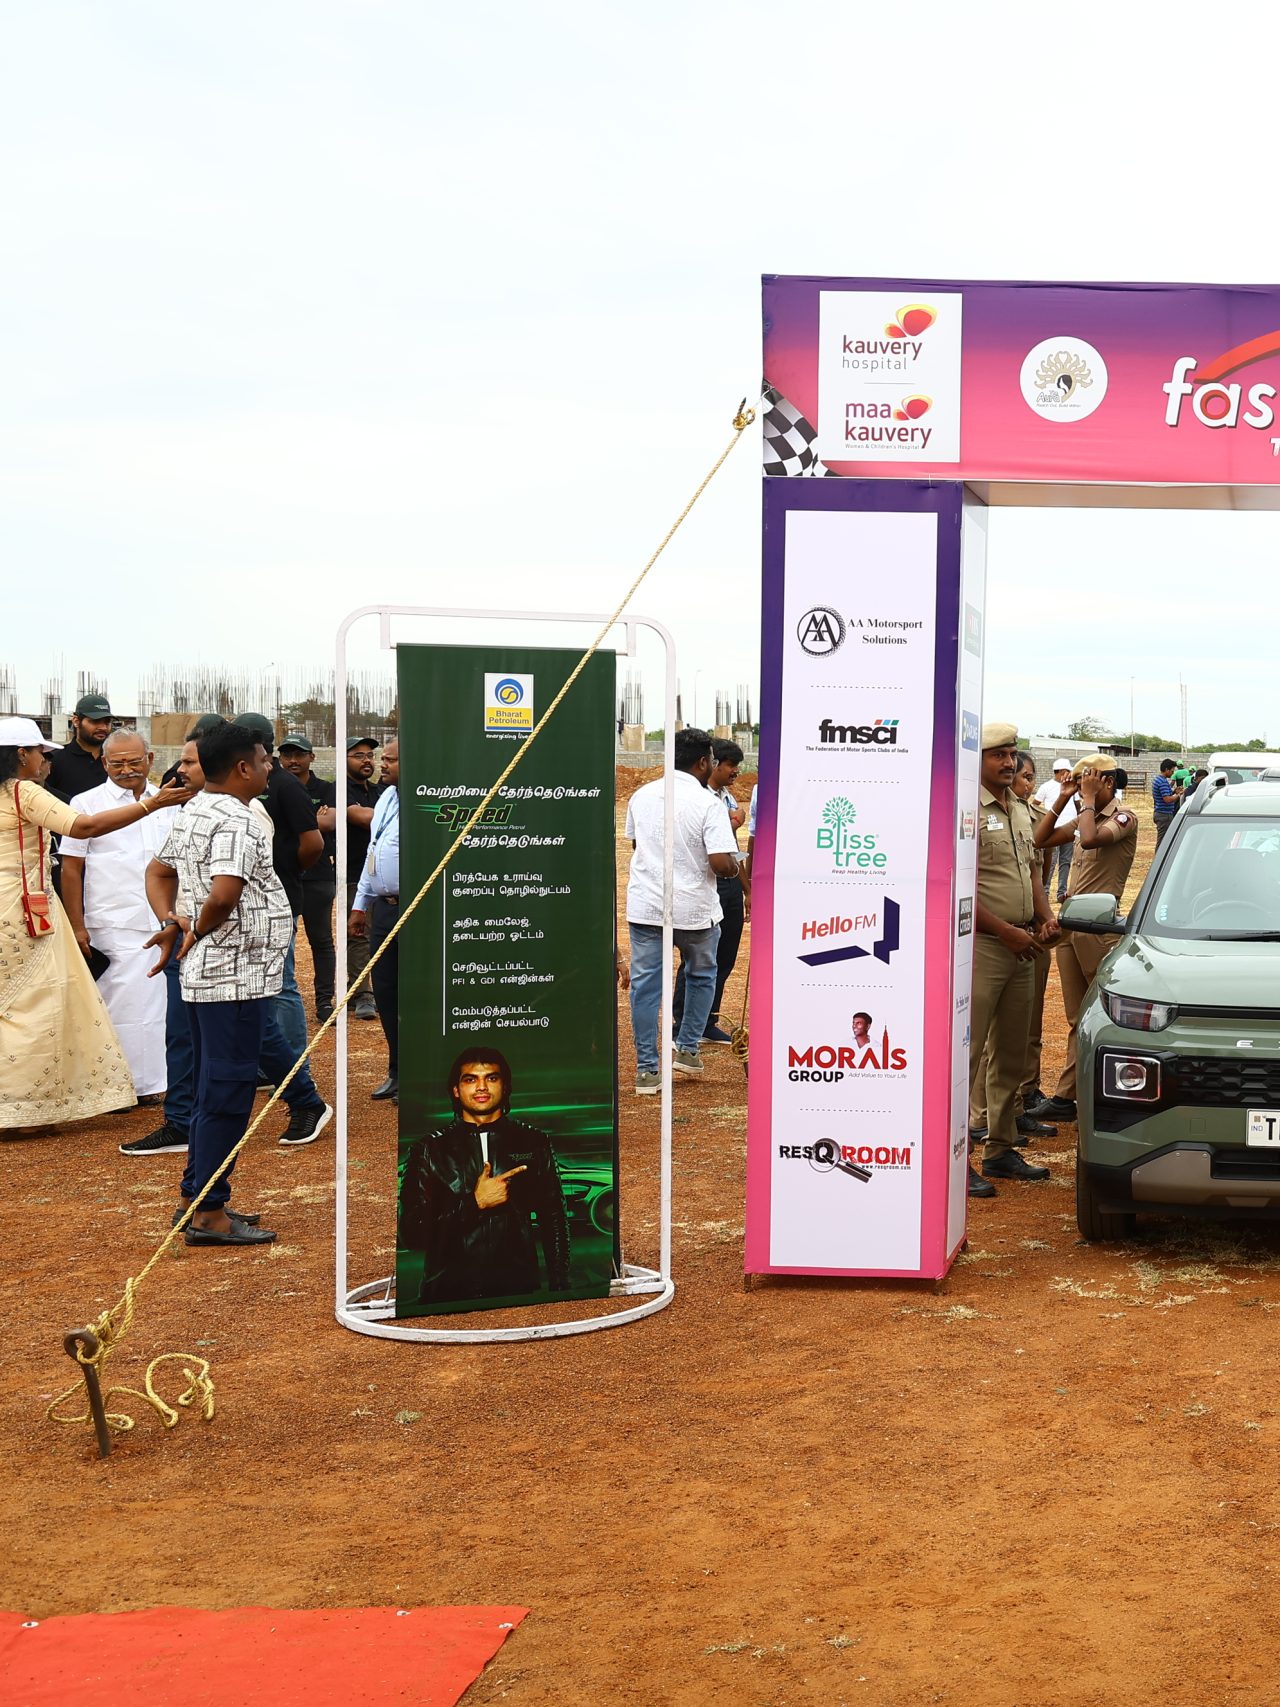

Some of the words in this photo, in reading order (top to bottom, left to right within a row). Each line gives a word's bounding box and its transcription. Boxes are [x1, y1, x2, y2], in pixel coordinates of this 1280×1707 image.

[843, 335, 922, 360] kauvery
[842, 356, 907, 373] hospital
[845, 402, 891, 418] maa
[845, 420, 932, 449] kauvery
[847, 618, 864, 628] AA
[867, 618, 923, 630] Motorsport
[862, 635, 907, 645] Solutions
[489, 717, 530, 725] Petroleum
[496, 710, 522, 718] Bharat
[819, 719, 899, 744] fmsci
[498, 786, 601, 800] தேர்ந்தெடுங்கள்
[461, 834, 566, 848] தேர்ந்தெடுங்கள்
[817, 827, 876, 849] Bliss
[833, 851, 887, 867] tree
[452, 872, 499, 884] பிரத்யேக
[503, 872, 543, 883] உராய்வு
[452, 885, 495, 898] குறைப்பு
[499, 884, 571, 898] தொழில்நுட்பம்
[453, 917, 479, 929] அதிக
[801, 915, 853, 941] Hello
[854, 913, 877, 931] FM
[452, 930, 505, 943] தடையற்ற
[510, 929, 544, 941] ஓட்டம்
[452, 960, 534, 974] செறிவூட்டப்பட்ட
[500, 973, 554, 985] என்ஜின்கள்
[452, 1004, 536, 1017] மேம்படுத்தப்பட்ட
[452, 1019, 491, 1031] என்ஜின்
[496, 1016, 550, 1028] செயல்பாடு
[788, 1044, 907, 1071] MORAIS
[788, 1070, 844, 1083] GROUP
